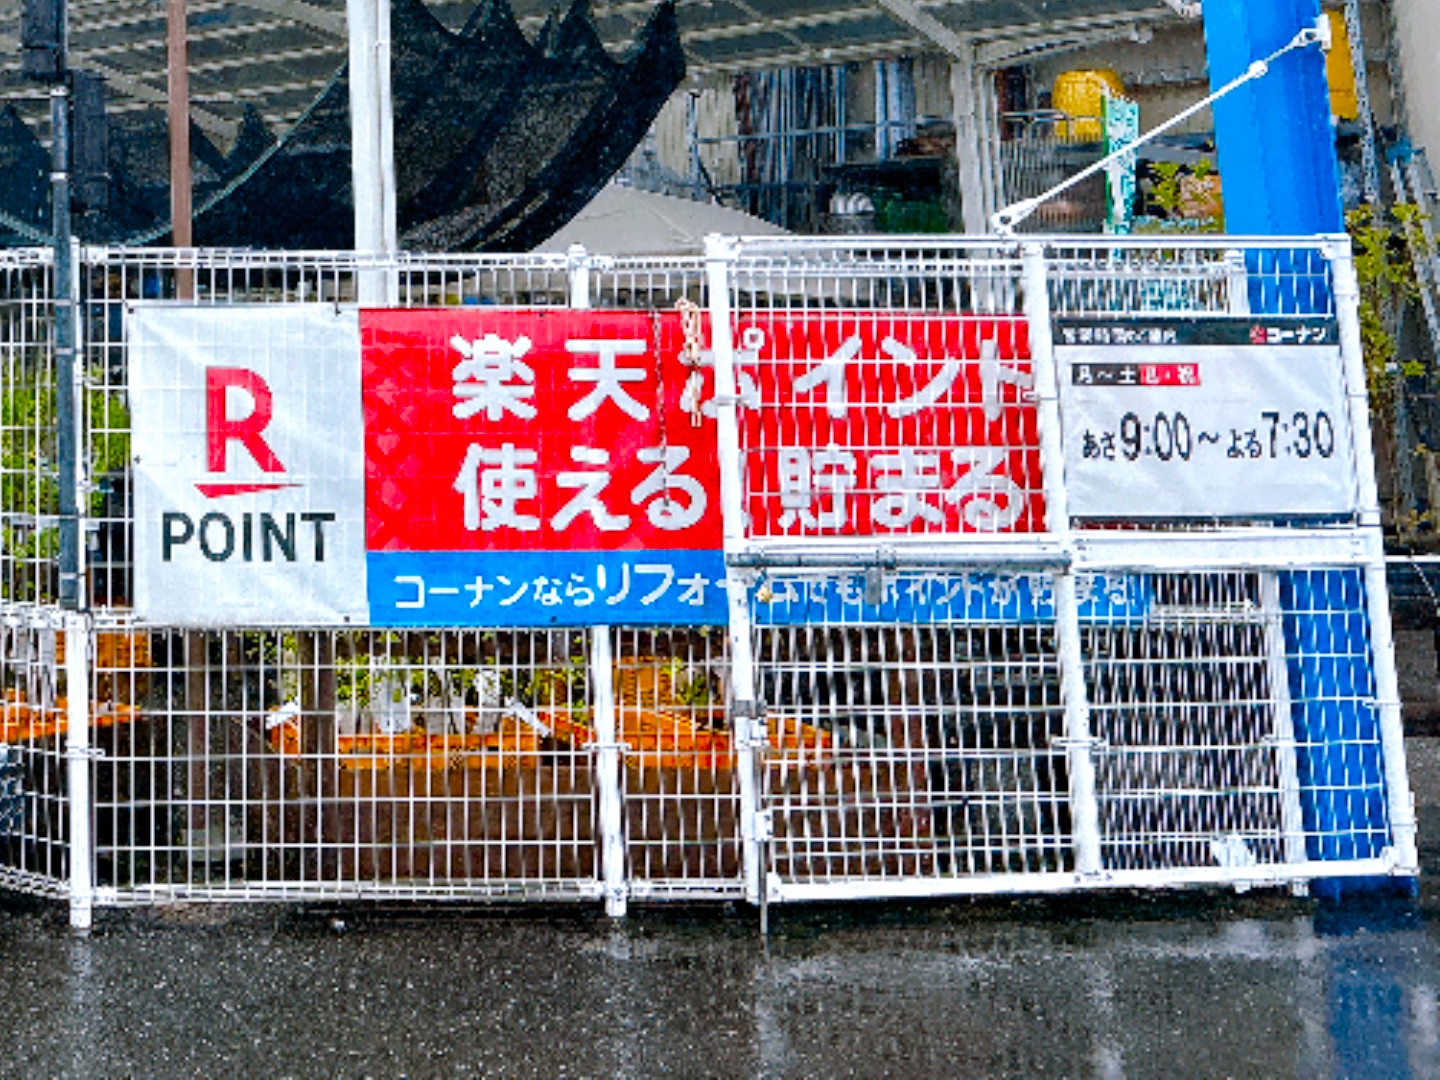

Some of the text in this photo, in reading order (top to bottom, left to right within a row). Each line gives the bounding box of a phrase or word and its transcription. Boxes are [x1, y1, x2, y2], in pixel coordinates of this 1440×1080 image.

[450, 330, 1033, 423] 楽天ポイント
[1266, 325, 1327, 344] コーナン
[205, 365, 288, 474] R
[452, 442, 1026, 532] 使える 貯まる
[162, 512, 336, 563] POINT
